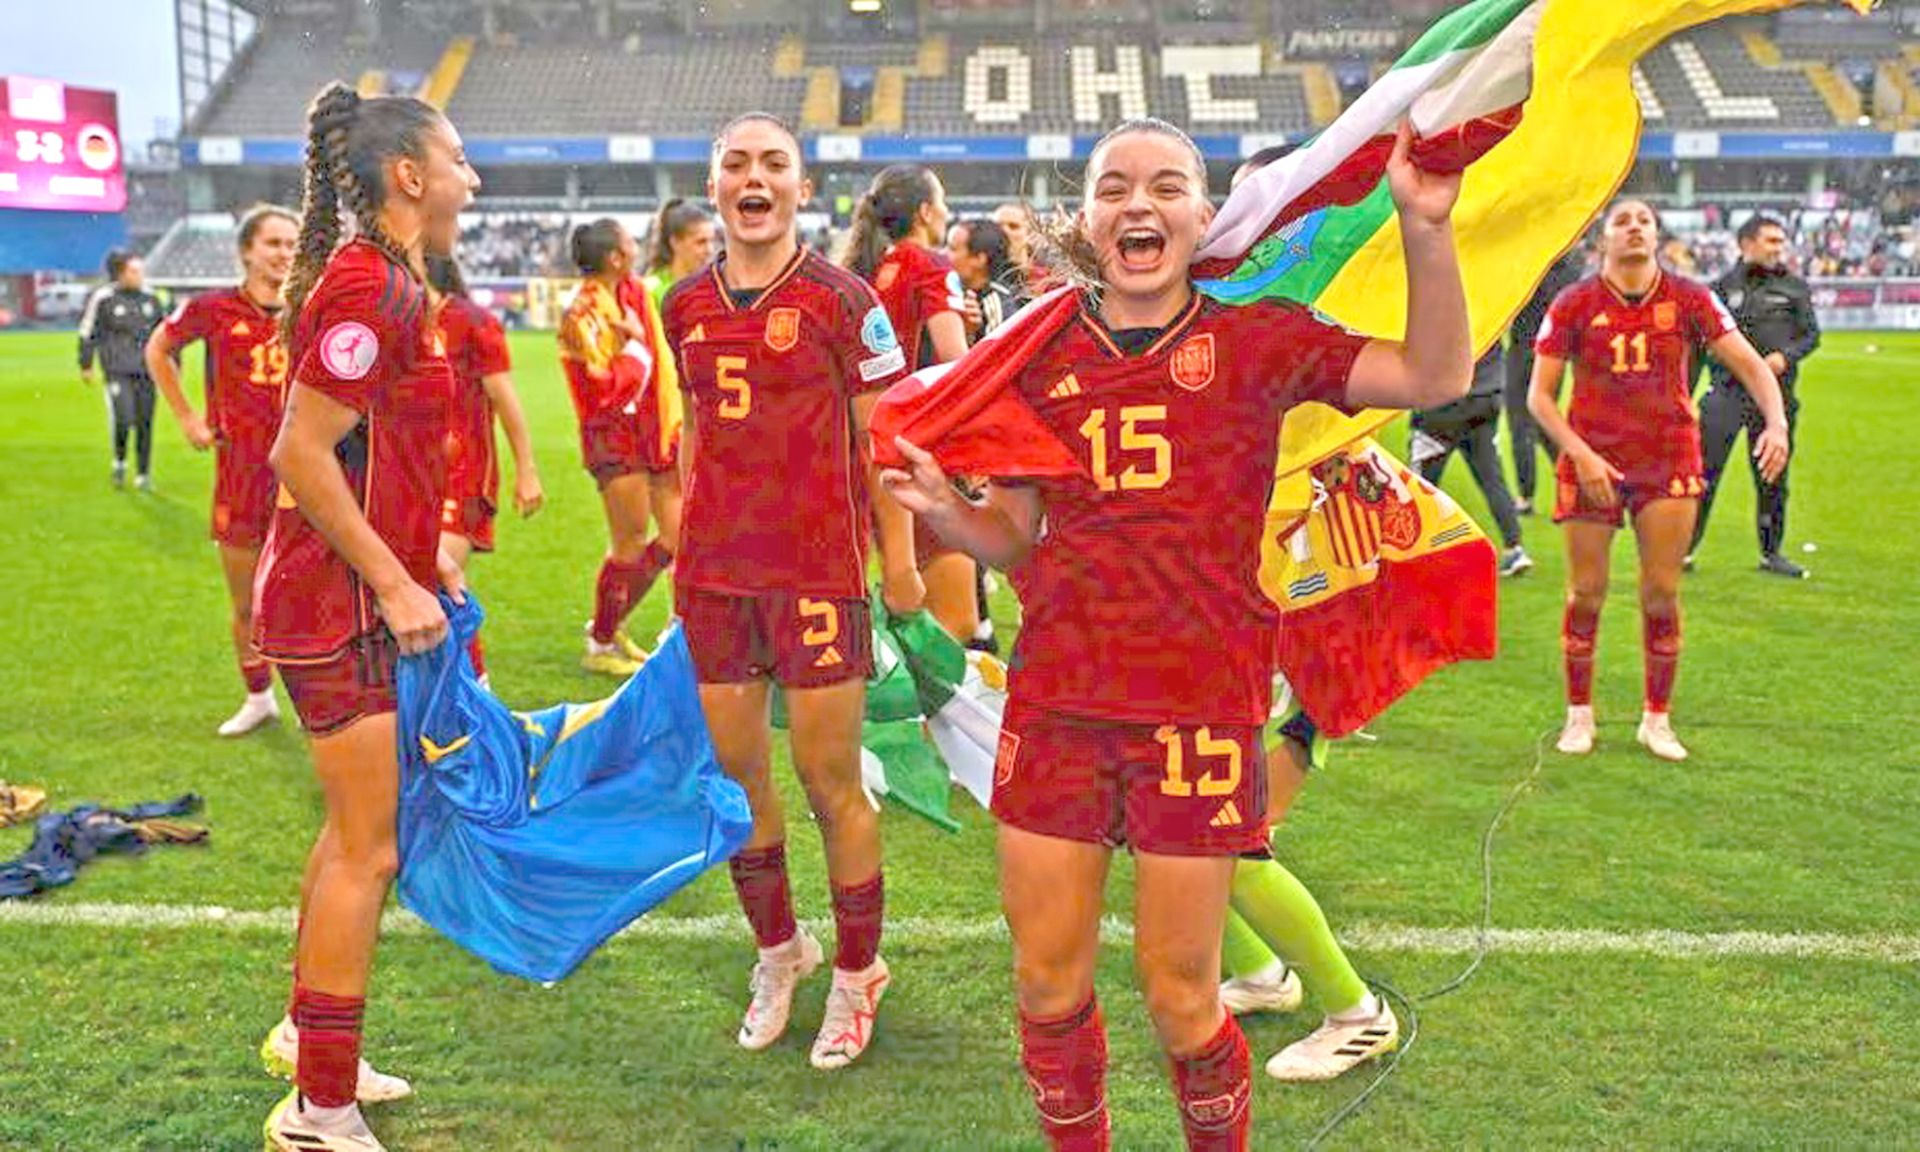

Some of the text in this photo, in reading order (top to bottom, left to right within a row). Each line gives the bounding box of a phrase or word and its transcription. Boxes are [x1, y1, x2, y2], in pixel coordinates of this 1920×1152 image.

[249, 344, 289, 385] 19
[1610, 331, 1650, 373] 11
[716, 356, 751, 419] 5
[1079, 405, 1171, 491] 15
[799, 598, 838, 646] 5
[1154, 724, 1242, 797] 15
